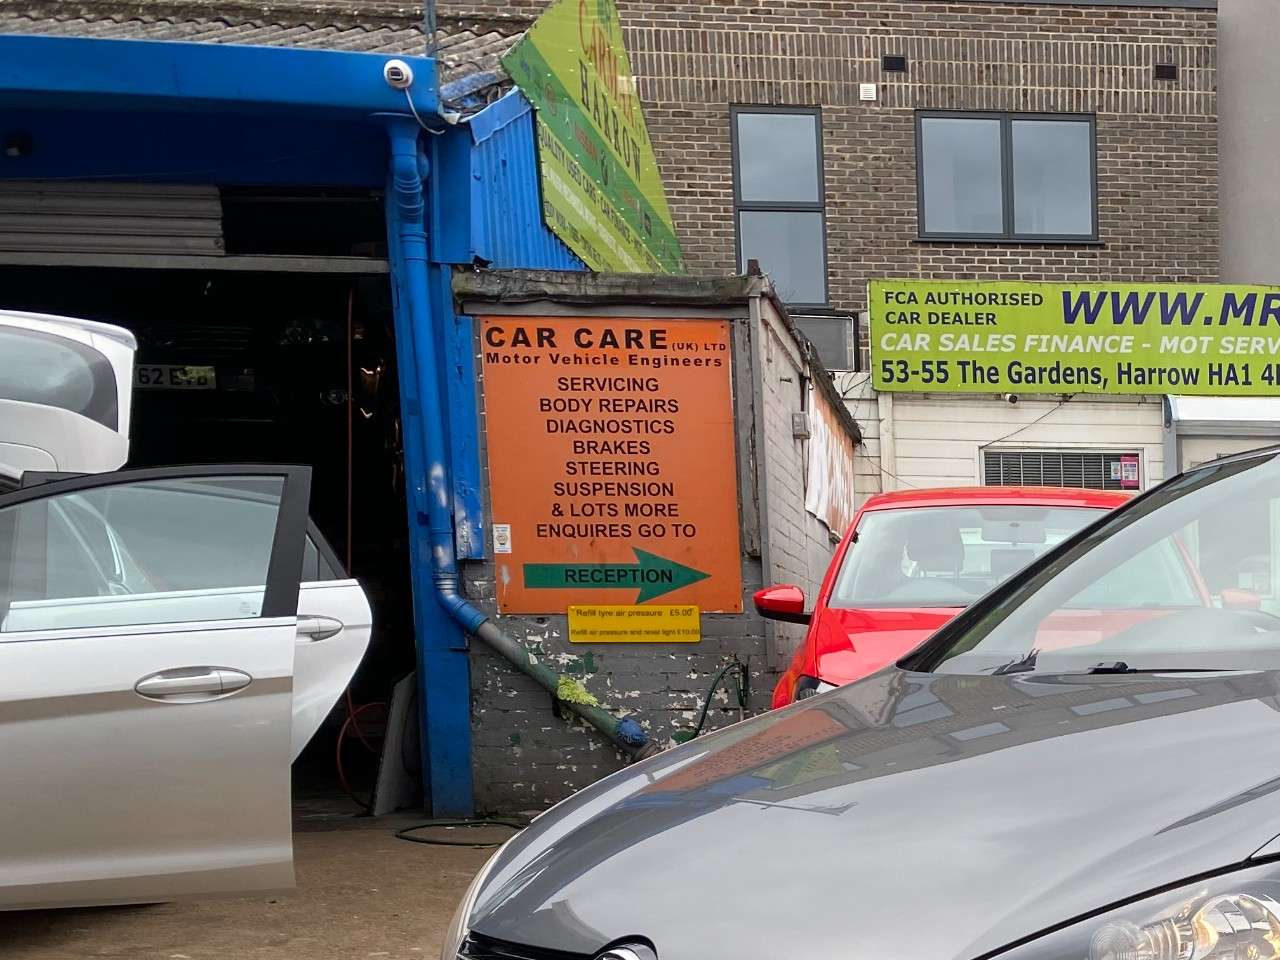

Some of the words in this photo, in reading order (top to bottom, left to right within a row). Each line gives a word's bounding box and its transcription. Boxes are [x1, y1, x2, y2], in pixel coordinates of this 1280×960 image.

[578, 58, 640, 183] HARROW
[885, 291, 918, 305] FCA
[925, 292, 1043, 306] AUTHORISED
[885, 311, 921, 325] CAR
[928, 312, 997, 326] DEALER
[485, 326, 557, 348] CAR
[574, 328, 668, 350] CARE
[671, 342, 699, 352] (UK)
[704, 342, 726, 351] LTD
[880, 333, 930, 351] CAR
[938, 334, 1017, 352] SALES
[1024, 335, 1135, 353] FINANCE
[1159, 336, 1213, 354] MOT
[486, 352, 540, 364] Motor
[549, 353, 620, 366] Vehicle
[628, 354, 723, 369] Engineers
[881, 360, 949, 384] 53-55
[957, 360, 1000, 384] The
[1007, 361, 1108, 390] Gardens,
[1117, 362, 1200, 386] Harrow
[1208, 363, 1252, 386] HA1
[557, 377, 659, 392] SERVICING
[539, 398, 592, 413] BODY
[600, 398, 679, 413] REPAIRS
[546, 419, 675, 434] DIAGNOSTICS
[573, 440, 651, 455] BRAKES
[565, 461, 660, 476] STEERING
[553, 482, 674, 497] SUSPENSION
[551, 503, 564, 517] &
[570, 503, 618, 517] LOTS
[625, 503, 679, 517] MORE
[536, 524, 632, 539] ENQUIRES
[638, 524, 666, 538] GO
[672, 524, 697, 538] TO
[564, 568, 674, 584] RECEPTION
[576, 608, 596, 617] Refill
[598, 609, 614, 618] tyre
[615, 609, 625, 617] air
[627, 610, 663, 618] pressure
[669, 608, 693, 617] £5.00
